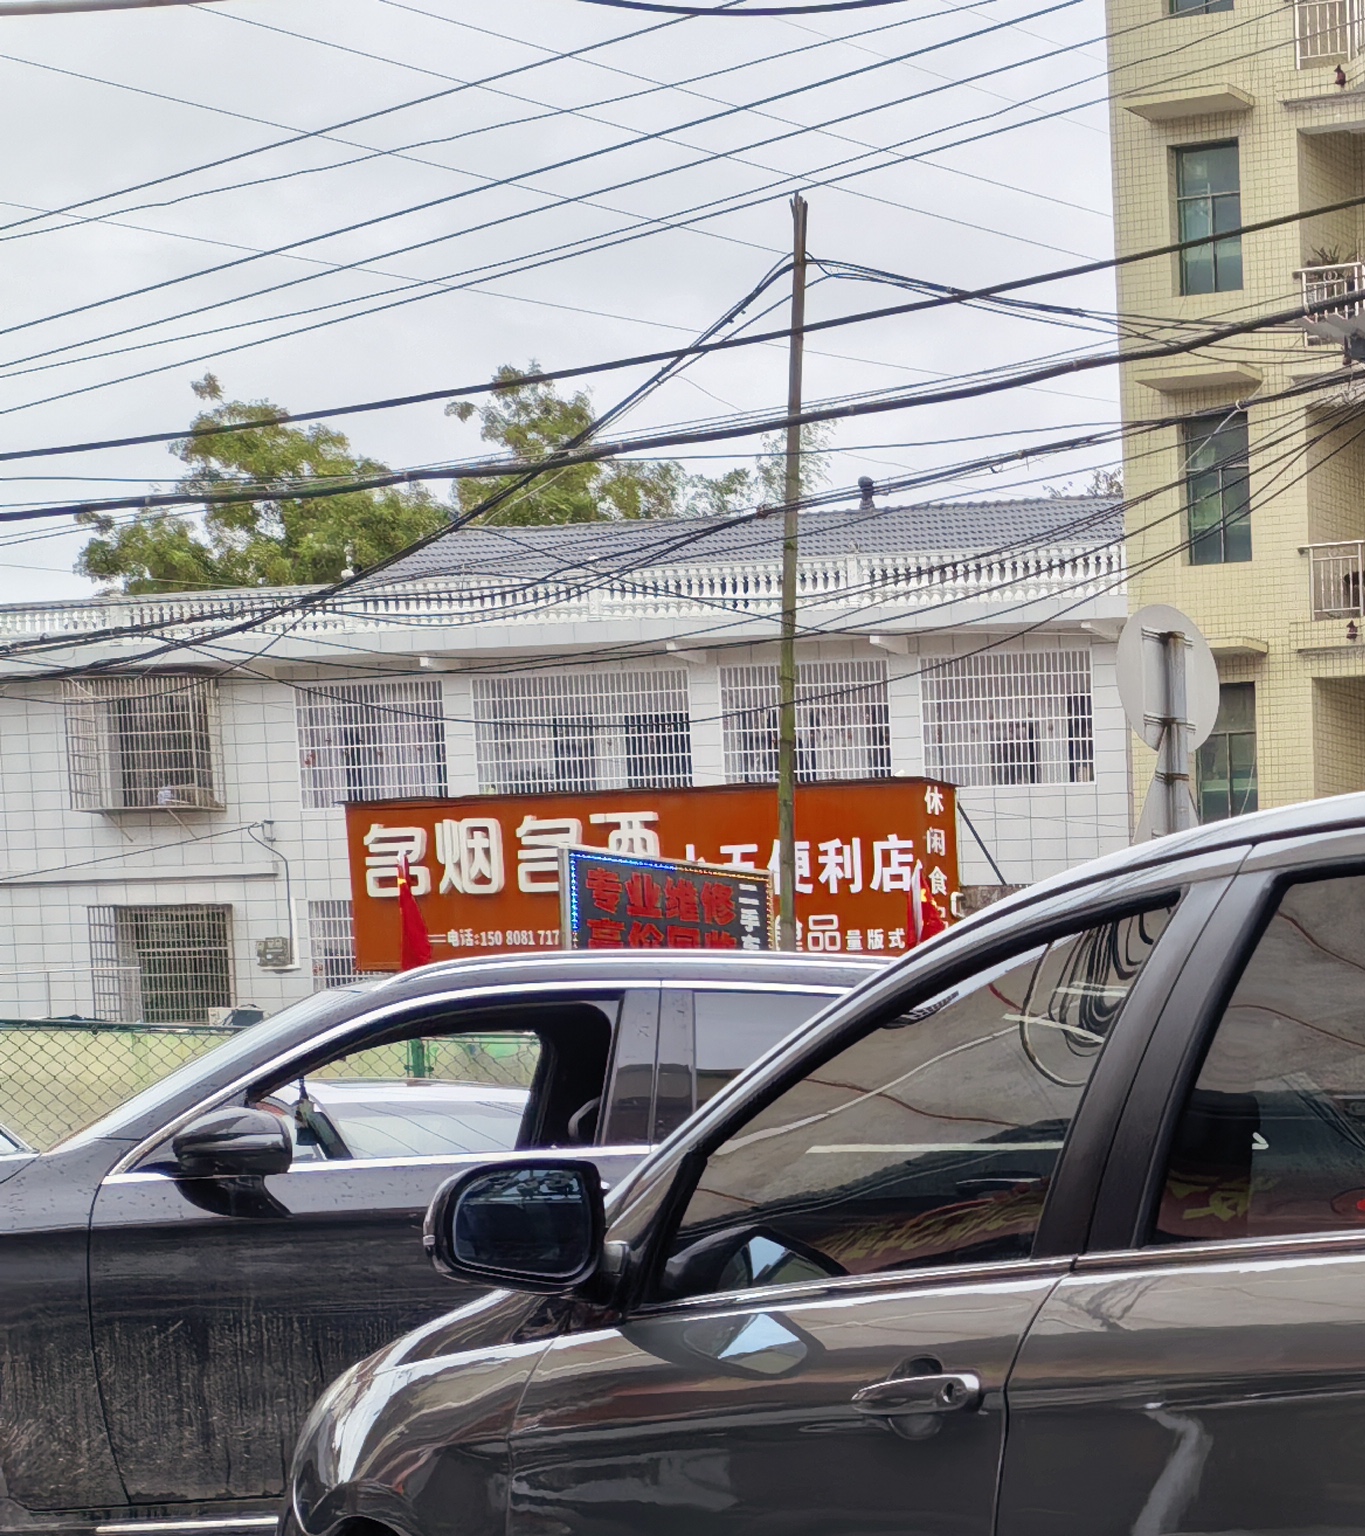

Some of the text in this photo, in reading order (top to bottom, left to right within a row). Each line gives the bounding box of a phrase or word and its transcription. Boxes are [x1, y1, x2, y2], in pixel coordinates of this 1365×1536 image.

[585, 867, 737, 926] 专业维修
[738, 883, 762, 949] 二手车
[505, 929, 536, 946] 8081
